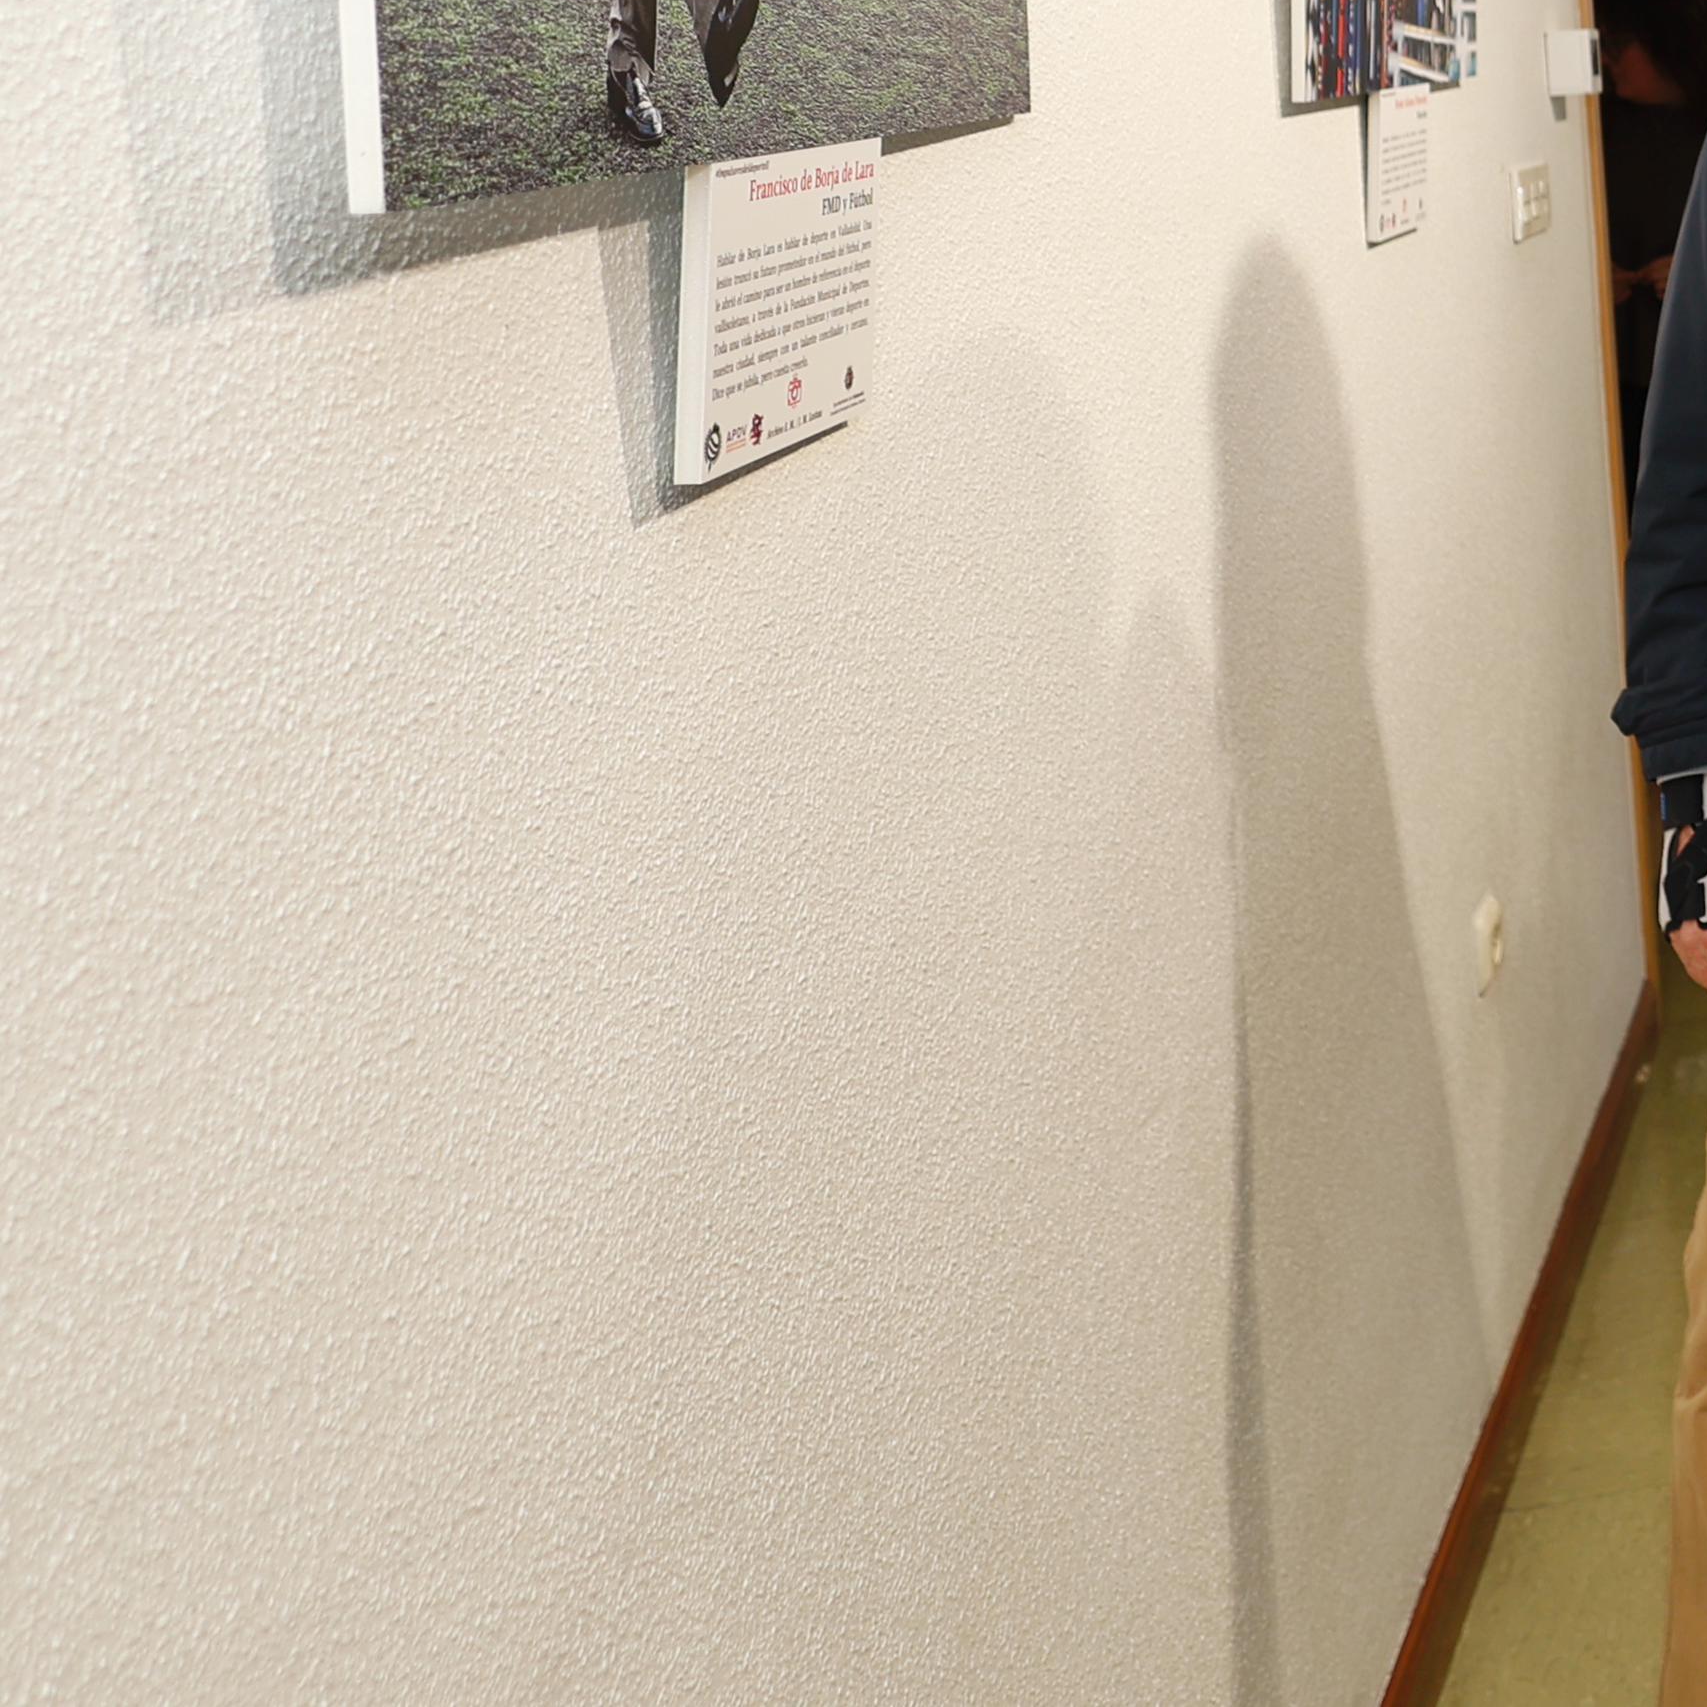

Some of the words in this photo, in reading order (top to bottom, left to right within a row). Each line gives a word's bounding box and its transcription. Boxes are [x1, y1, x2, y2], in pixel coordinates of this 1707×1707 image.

[749, 175, 799, 201] Francisco
[801, 169, 812, 191] de
[815, 166, 840, 190] Borja
[842, 161, 852, 183] de
[855, 161, 874, 180] Lara
[822, 195, 841, 216] FMD
[842, 200, 848, 215] y
[849, 187, 874, 210] Fútbol
